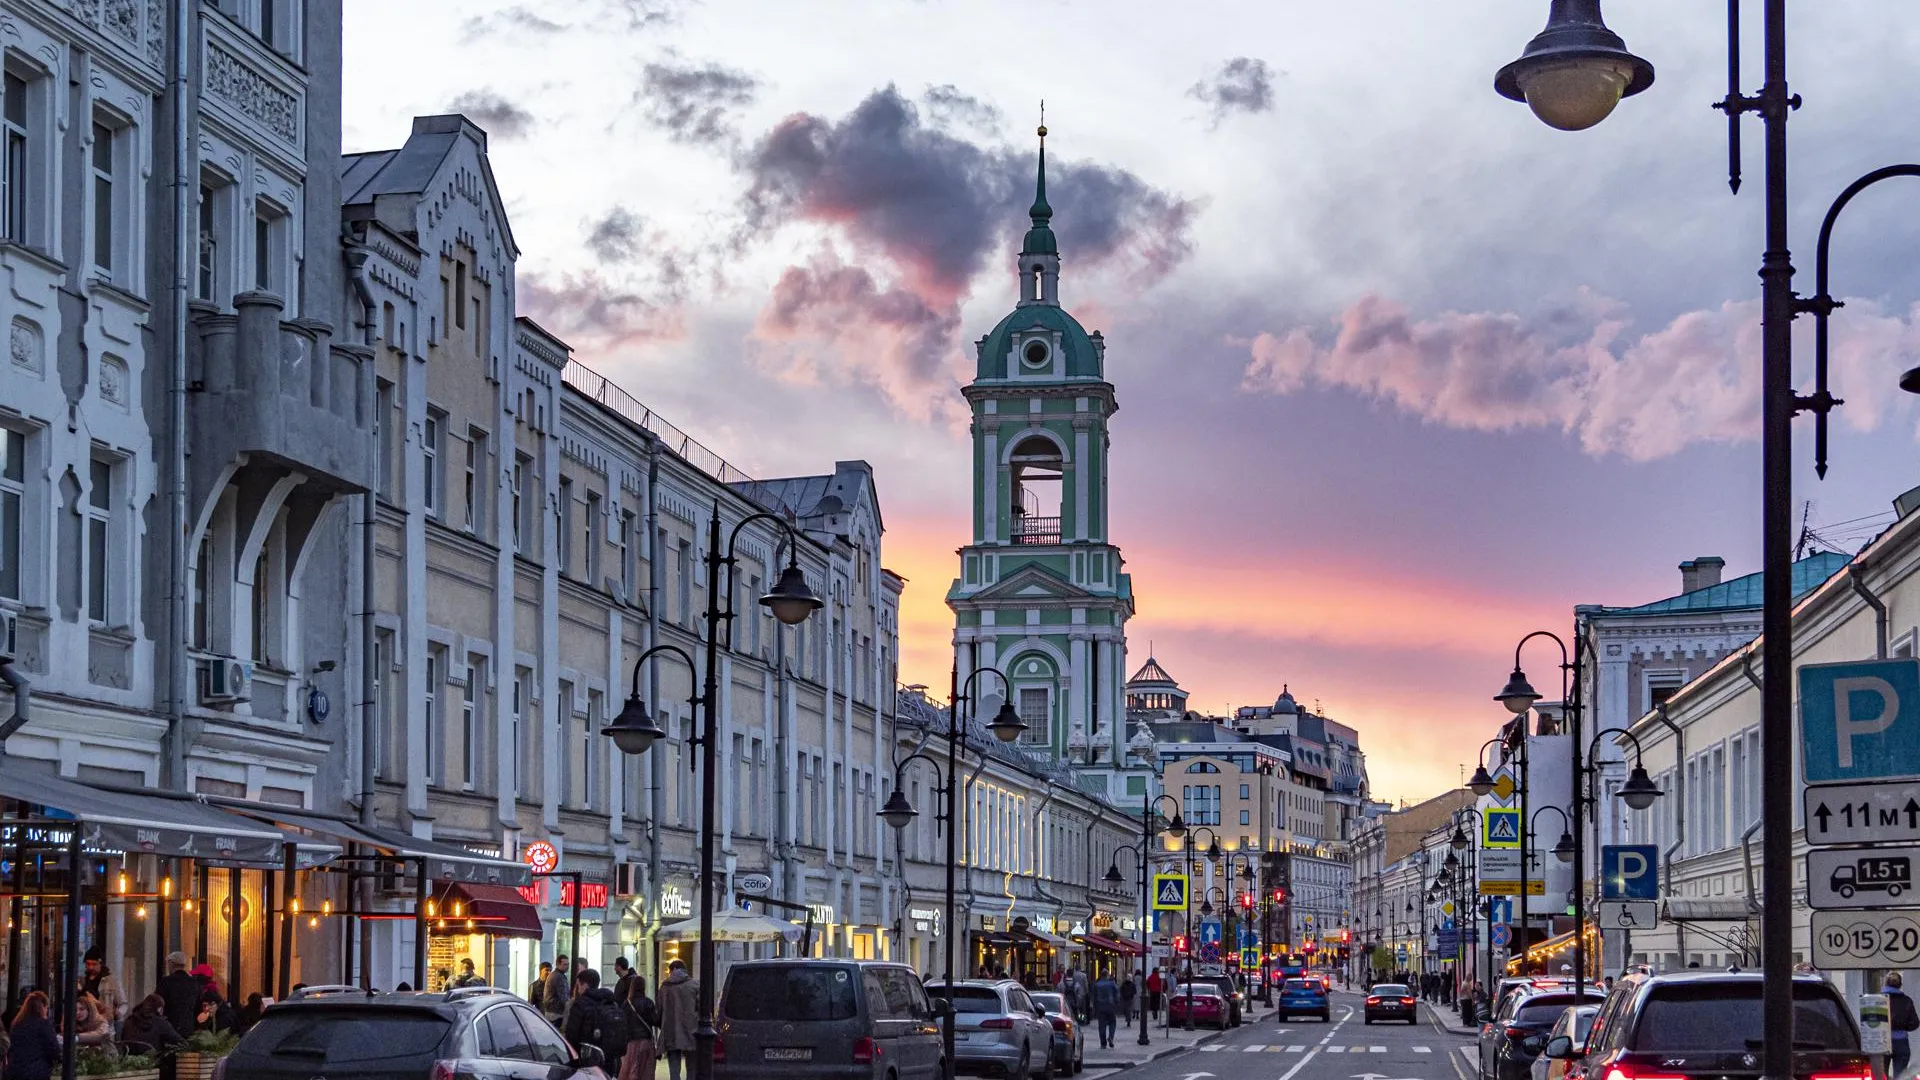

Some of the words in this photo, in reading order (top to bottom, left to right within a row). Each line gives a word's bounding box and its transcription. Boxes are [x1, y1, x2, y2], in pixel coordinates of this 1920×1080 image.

[317, 695, 327, 713] 10
[1833, 676, 1899, 767] P
[1840, 802, 1870, 828] 11
[137, 829, 160, 844] FRANK
[215, 837, 237, 850] FRANK
[526, 843, 555, 859] ПРОДУКТЫ
[1618, 852, 1648, 894] P
[744, 880, 767, 889] cofix
[662, 887, 682, 915] cofix
[805, 904, 834, 925] ICANTO
[1826, 932, 1844, 948] 10
[1851, 930, 1874, 949] 15
[1884, 927, 1918, 951] 20
